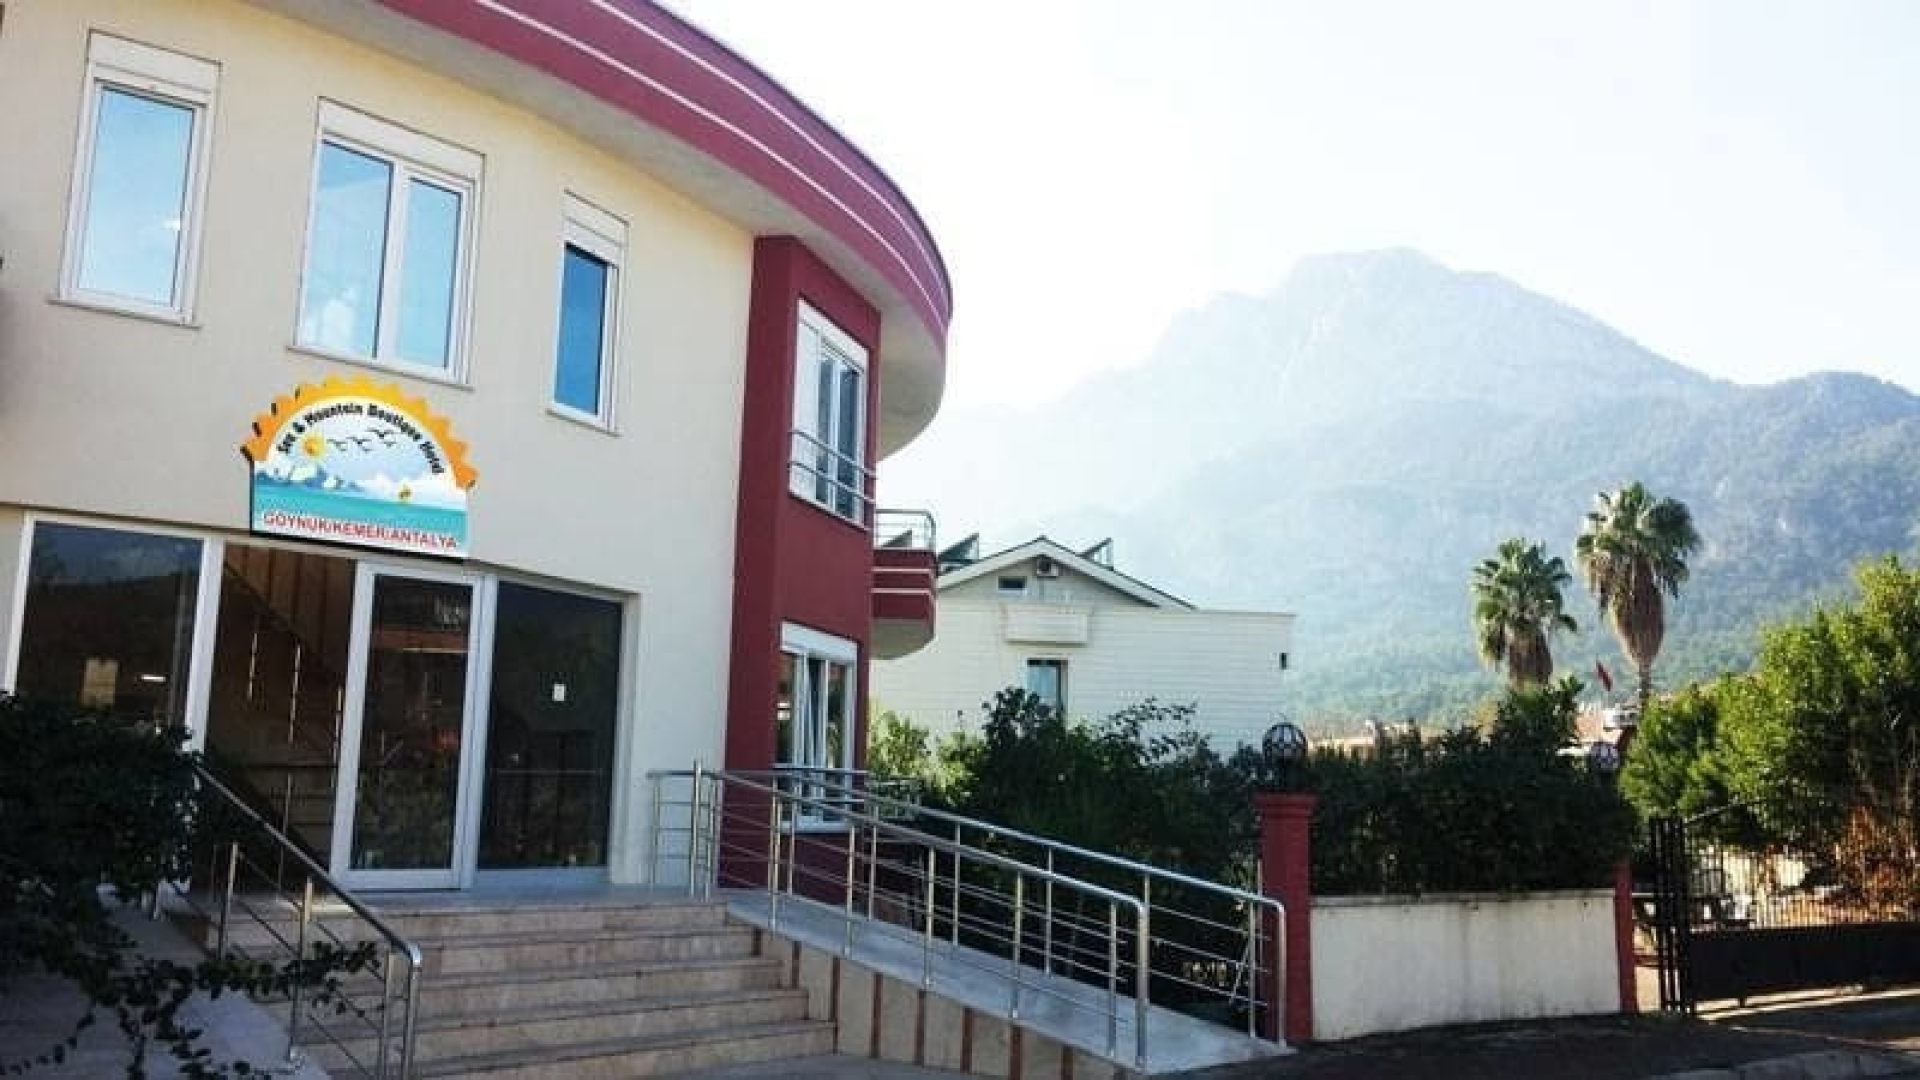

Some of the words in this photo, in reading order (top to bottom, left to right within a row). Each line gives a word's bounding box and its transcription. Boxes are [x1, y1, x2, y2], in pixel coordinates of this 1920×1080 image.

[303, 403, 363, 426] Mountain
[367, 403, 422, 442] Boutique
[419, 441, 445, 474] Hotel
